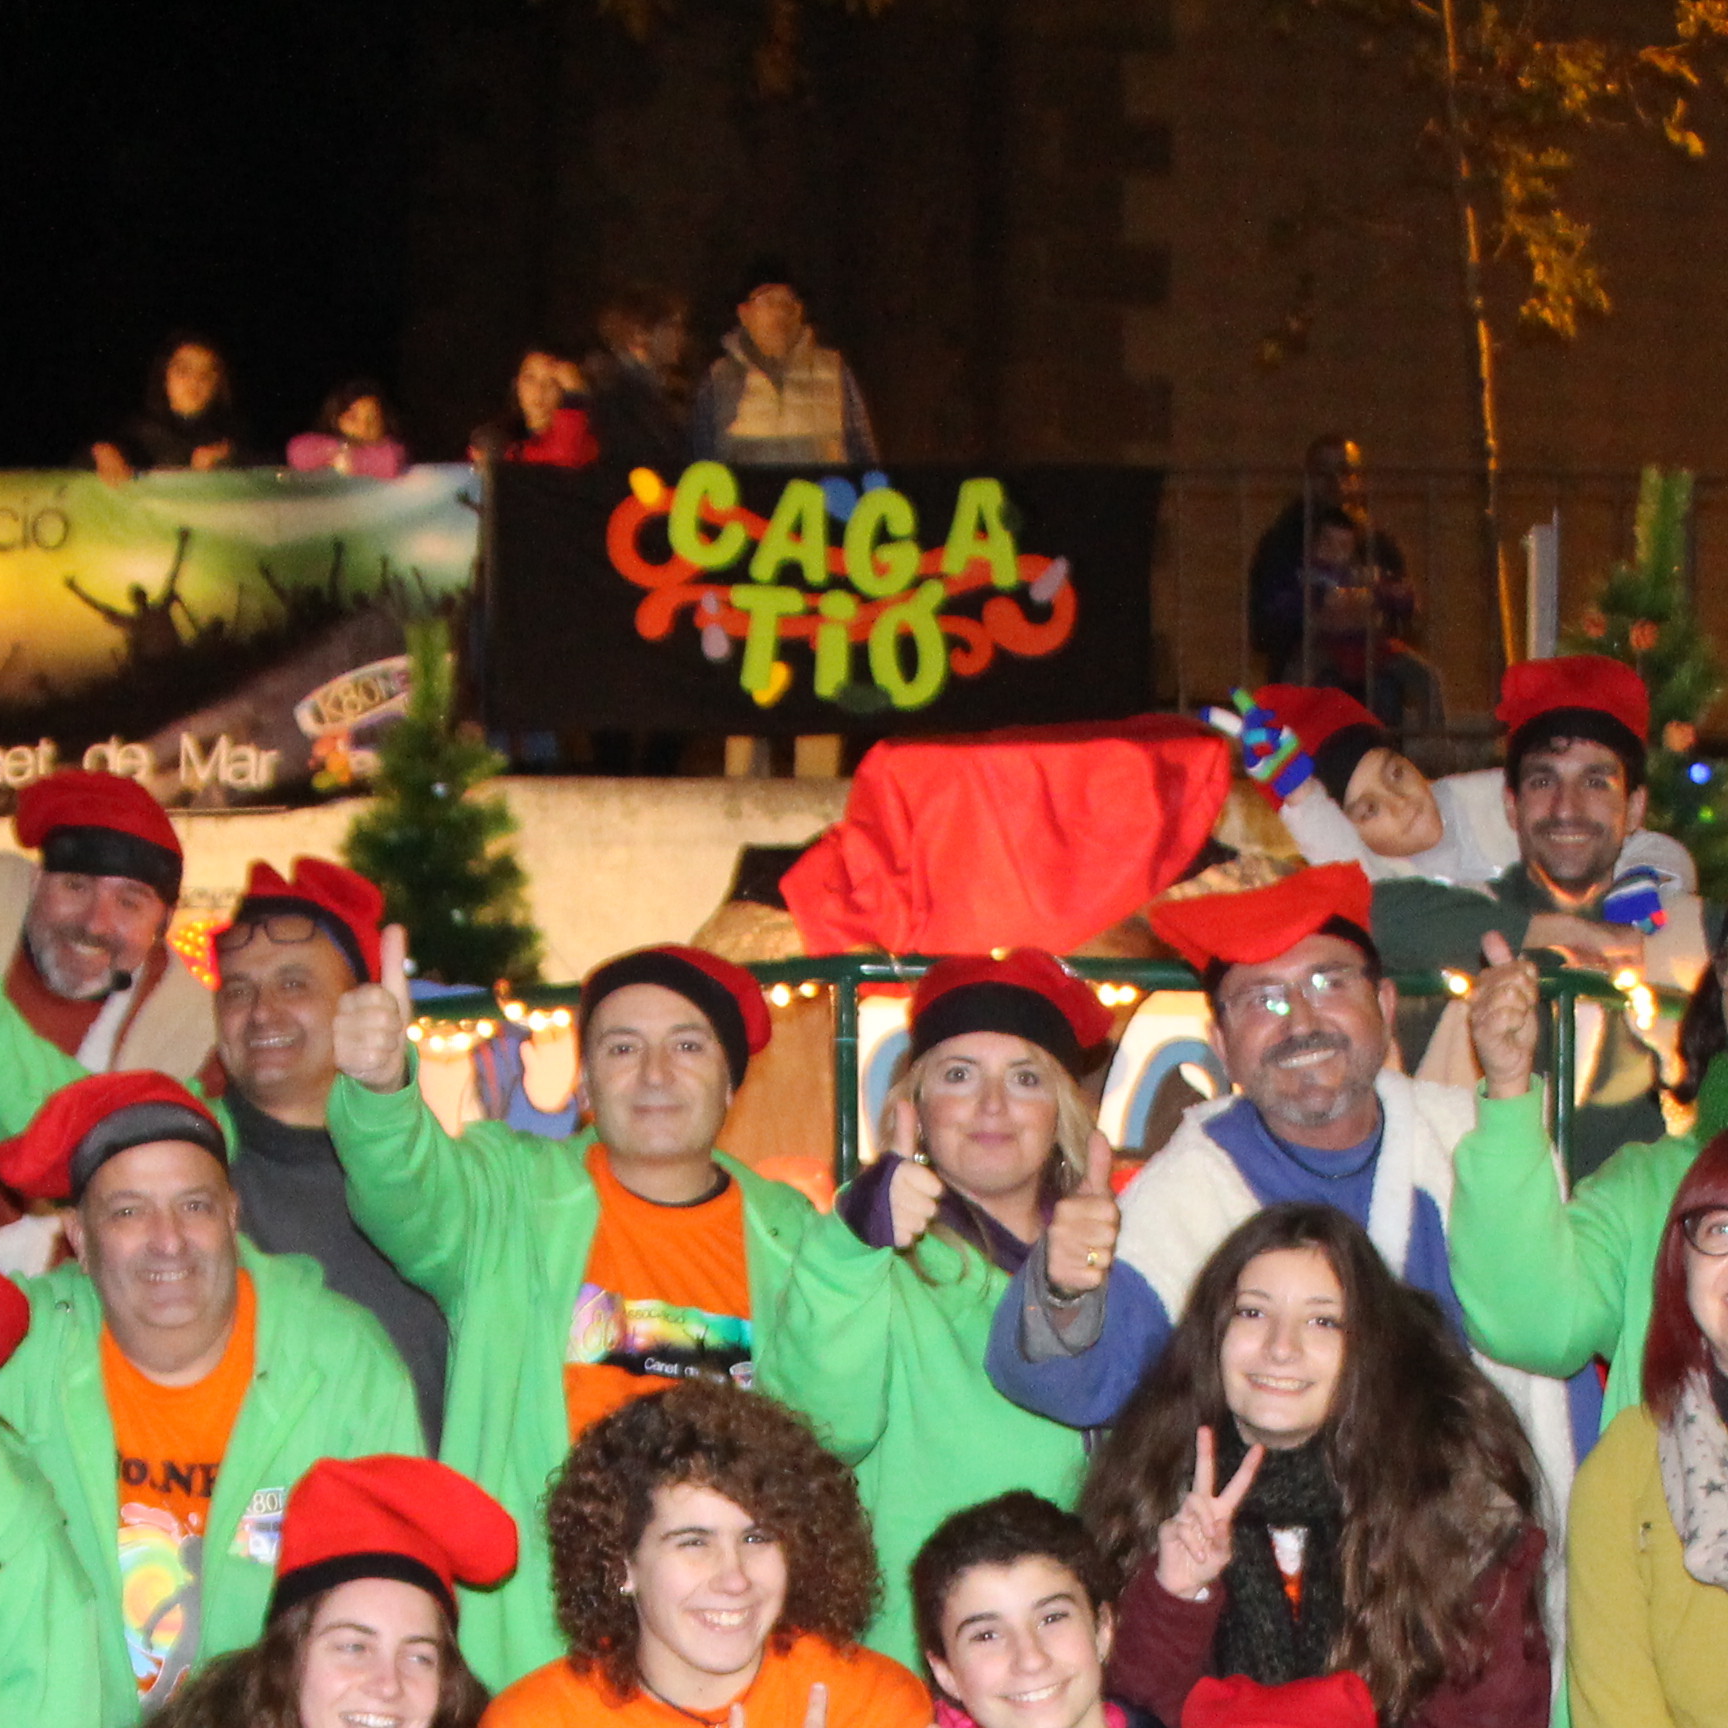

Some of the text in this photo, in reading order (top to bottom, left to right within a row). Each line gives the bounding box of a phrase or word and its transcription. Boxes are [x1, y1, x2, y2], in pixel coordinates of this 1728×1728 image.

[668, 461, 1020, 598] CAGA
[82, 734, 152, 774] de
[179, 731, 281, 791] Mar
[644, 1357, 678, 1375] Canet
